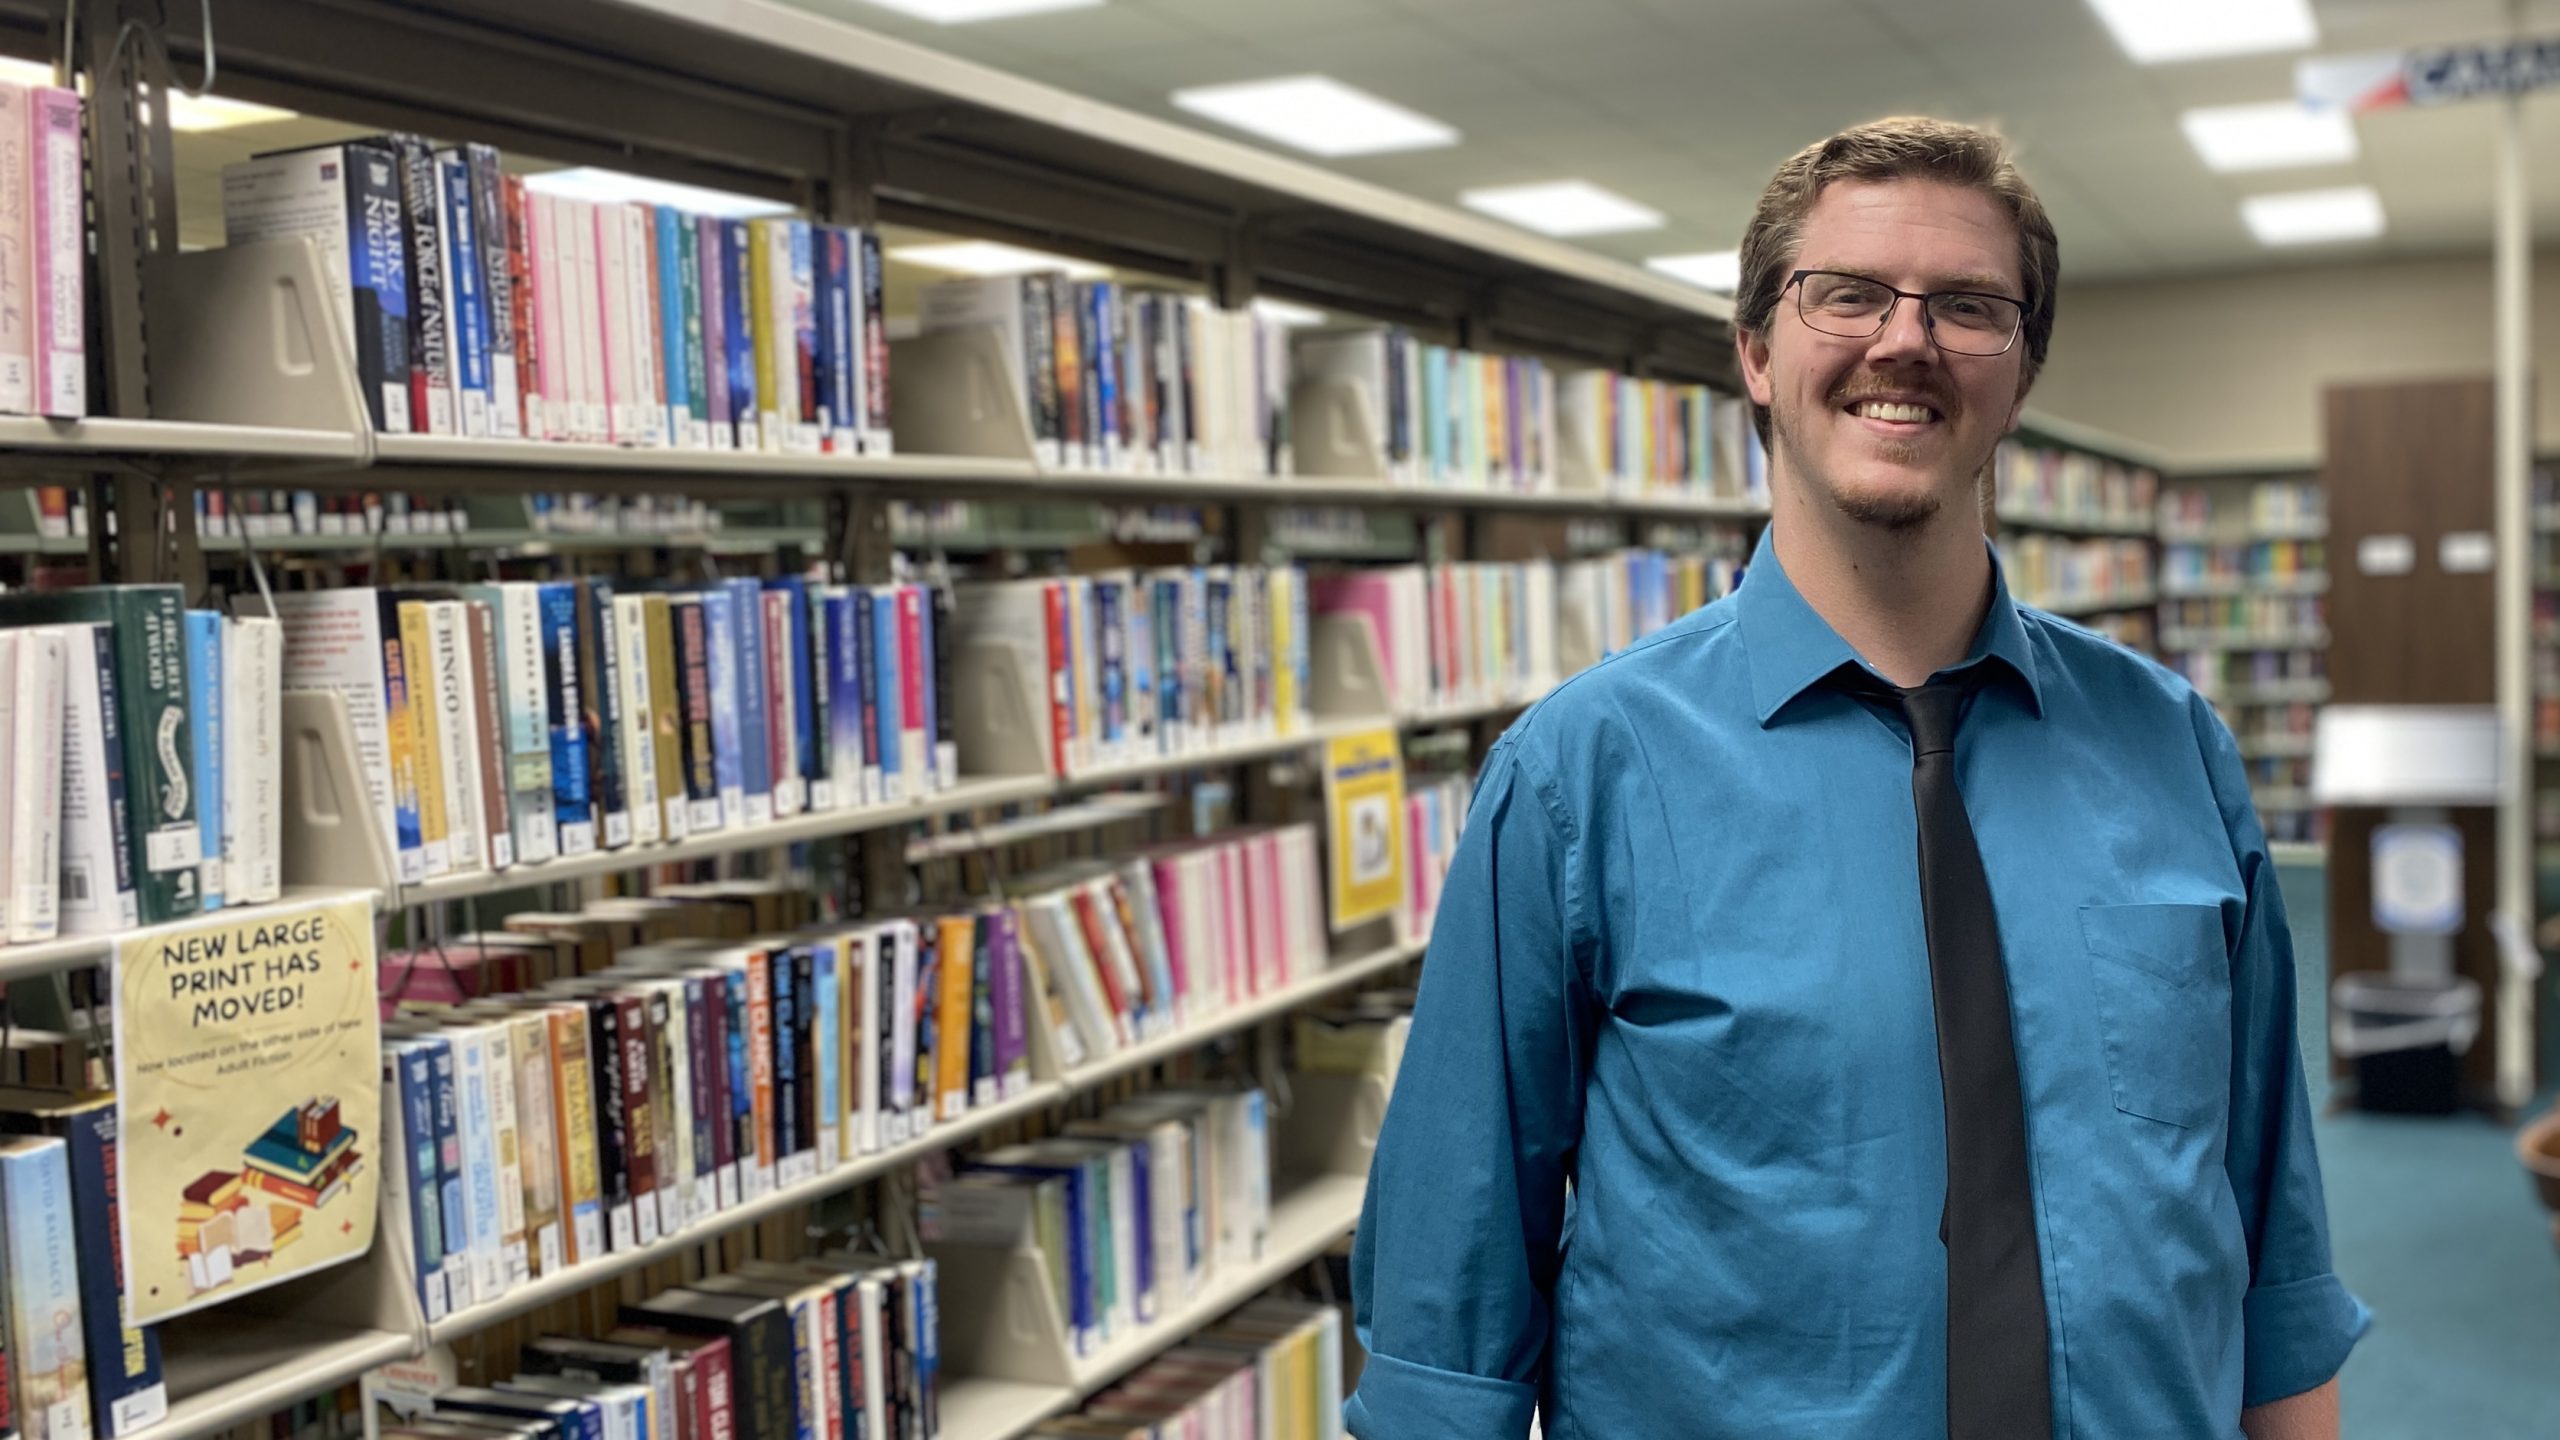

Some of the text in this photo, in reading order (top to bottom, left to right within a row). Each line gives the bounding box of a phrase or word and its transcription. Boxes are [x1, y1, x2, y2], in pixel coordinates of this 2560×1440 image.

[364, 193, 387, 291] NIGHT
[382, 198, 403, 276] DARK
[146, 608, 164, 690] ATWOOD
[161, 596, 182, 699] MARGARET
[437, 628, 460, 714] BINGO
[557, 626, 580, 741] SANDRA BROWN
[163, 917, 324, 968] NEW LARGE
[170, 950, 321, 999] PRINT HAS
[192, 983, 304, 1029] MOVED!
[136, 1060, 165, 1075] Now
[167, 1048, 217, 1068] located
[219, 1044, 237, 1056] on
[238, 1038, 259, 1052] the
[261, 1032, 294, 1048] other
[297, 1024, 321, 1041] side
[323, 1020, 336, 1034] of
[252, 1050, 293, 1069] Fiction
[38, 1156, 64, 1298] DAVID BALDACCI
